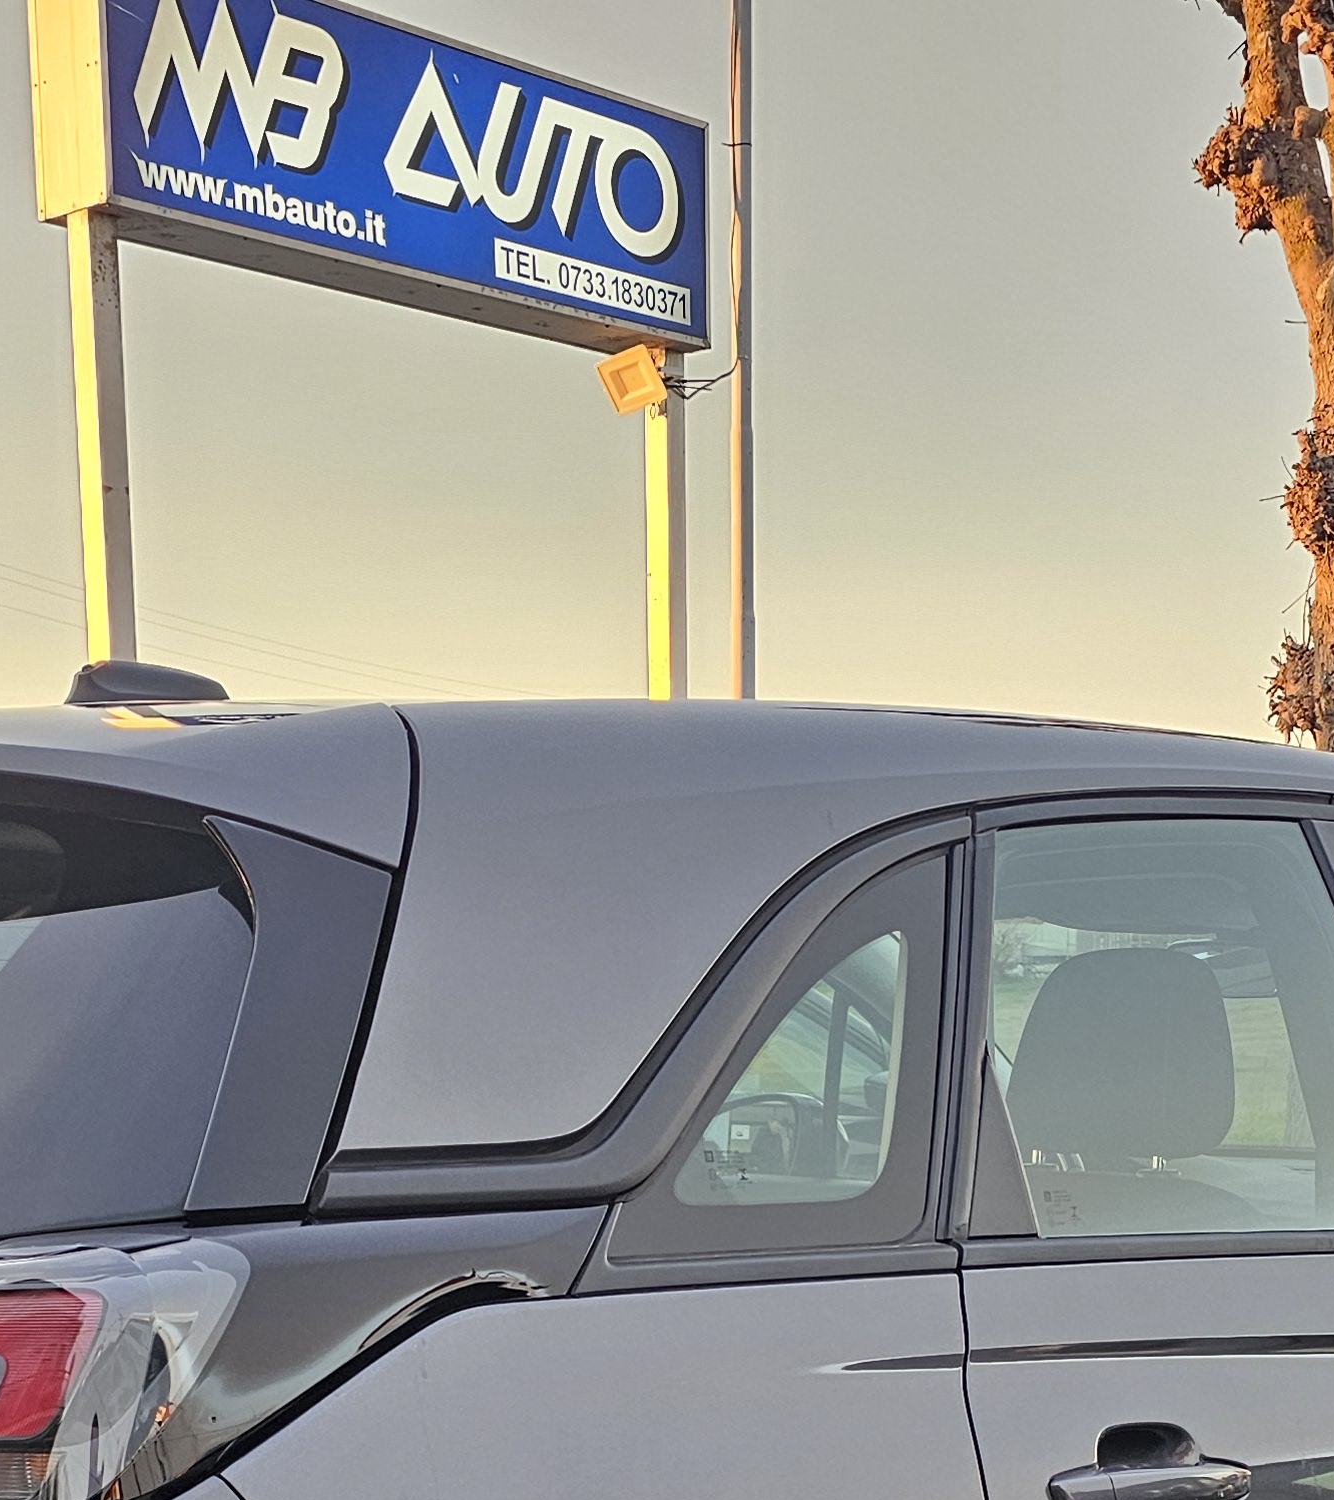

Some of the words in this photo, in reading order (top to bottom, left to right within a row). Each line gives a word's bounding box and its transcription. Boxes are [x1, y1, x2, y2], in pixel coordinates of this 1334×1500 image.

[384, 50, 679, 258] AUTO
[136, 158, 387, 247] www.mbauto.it
[500, 245, 551, 285] TEL.
[558, 265, 689, 320] 0733.1830371
